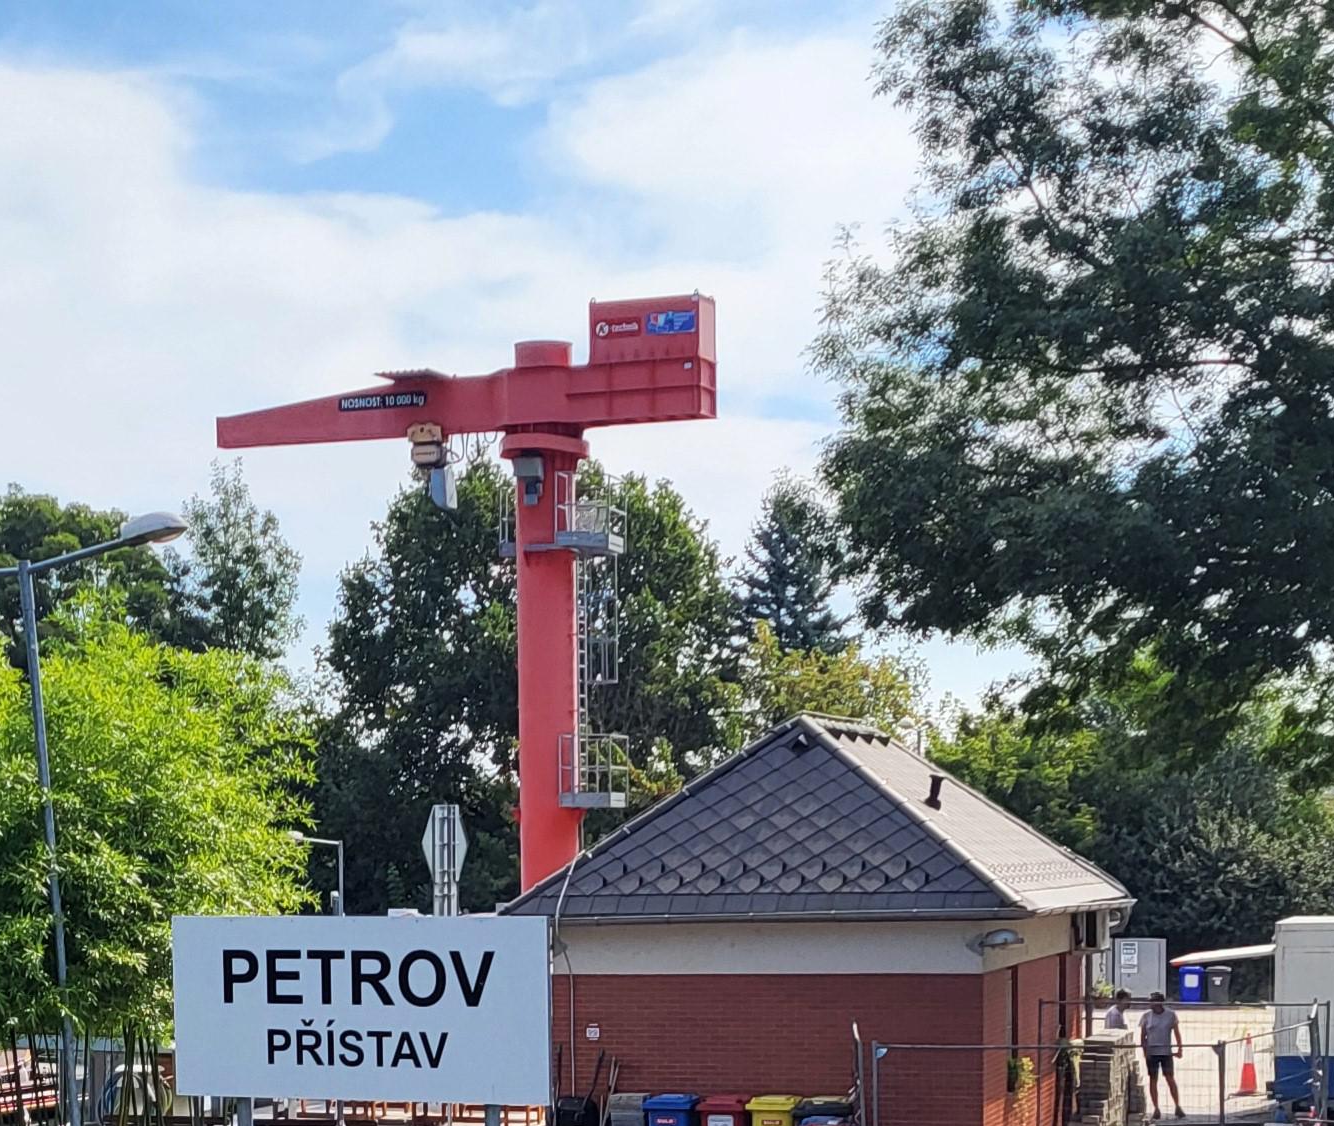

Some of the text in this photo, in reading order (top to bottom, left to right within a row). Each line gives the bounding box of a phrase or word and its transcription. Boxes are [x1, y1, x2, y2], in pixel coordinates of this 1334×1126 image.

[341, 393, 425, 409] NOSNOST: 10 000 kg
[221, 948, 495, 1008] PETROV
[267, 1019, 449, 1069] PŘÍSTAV
